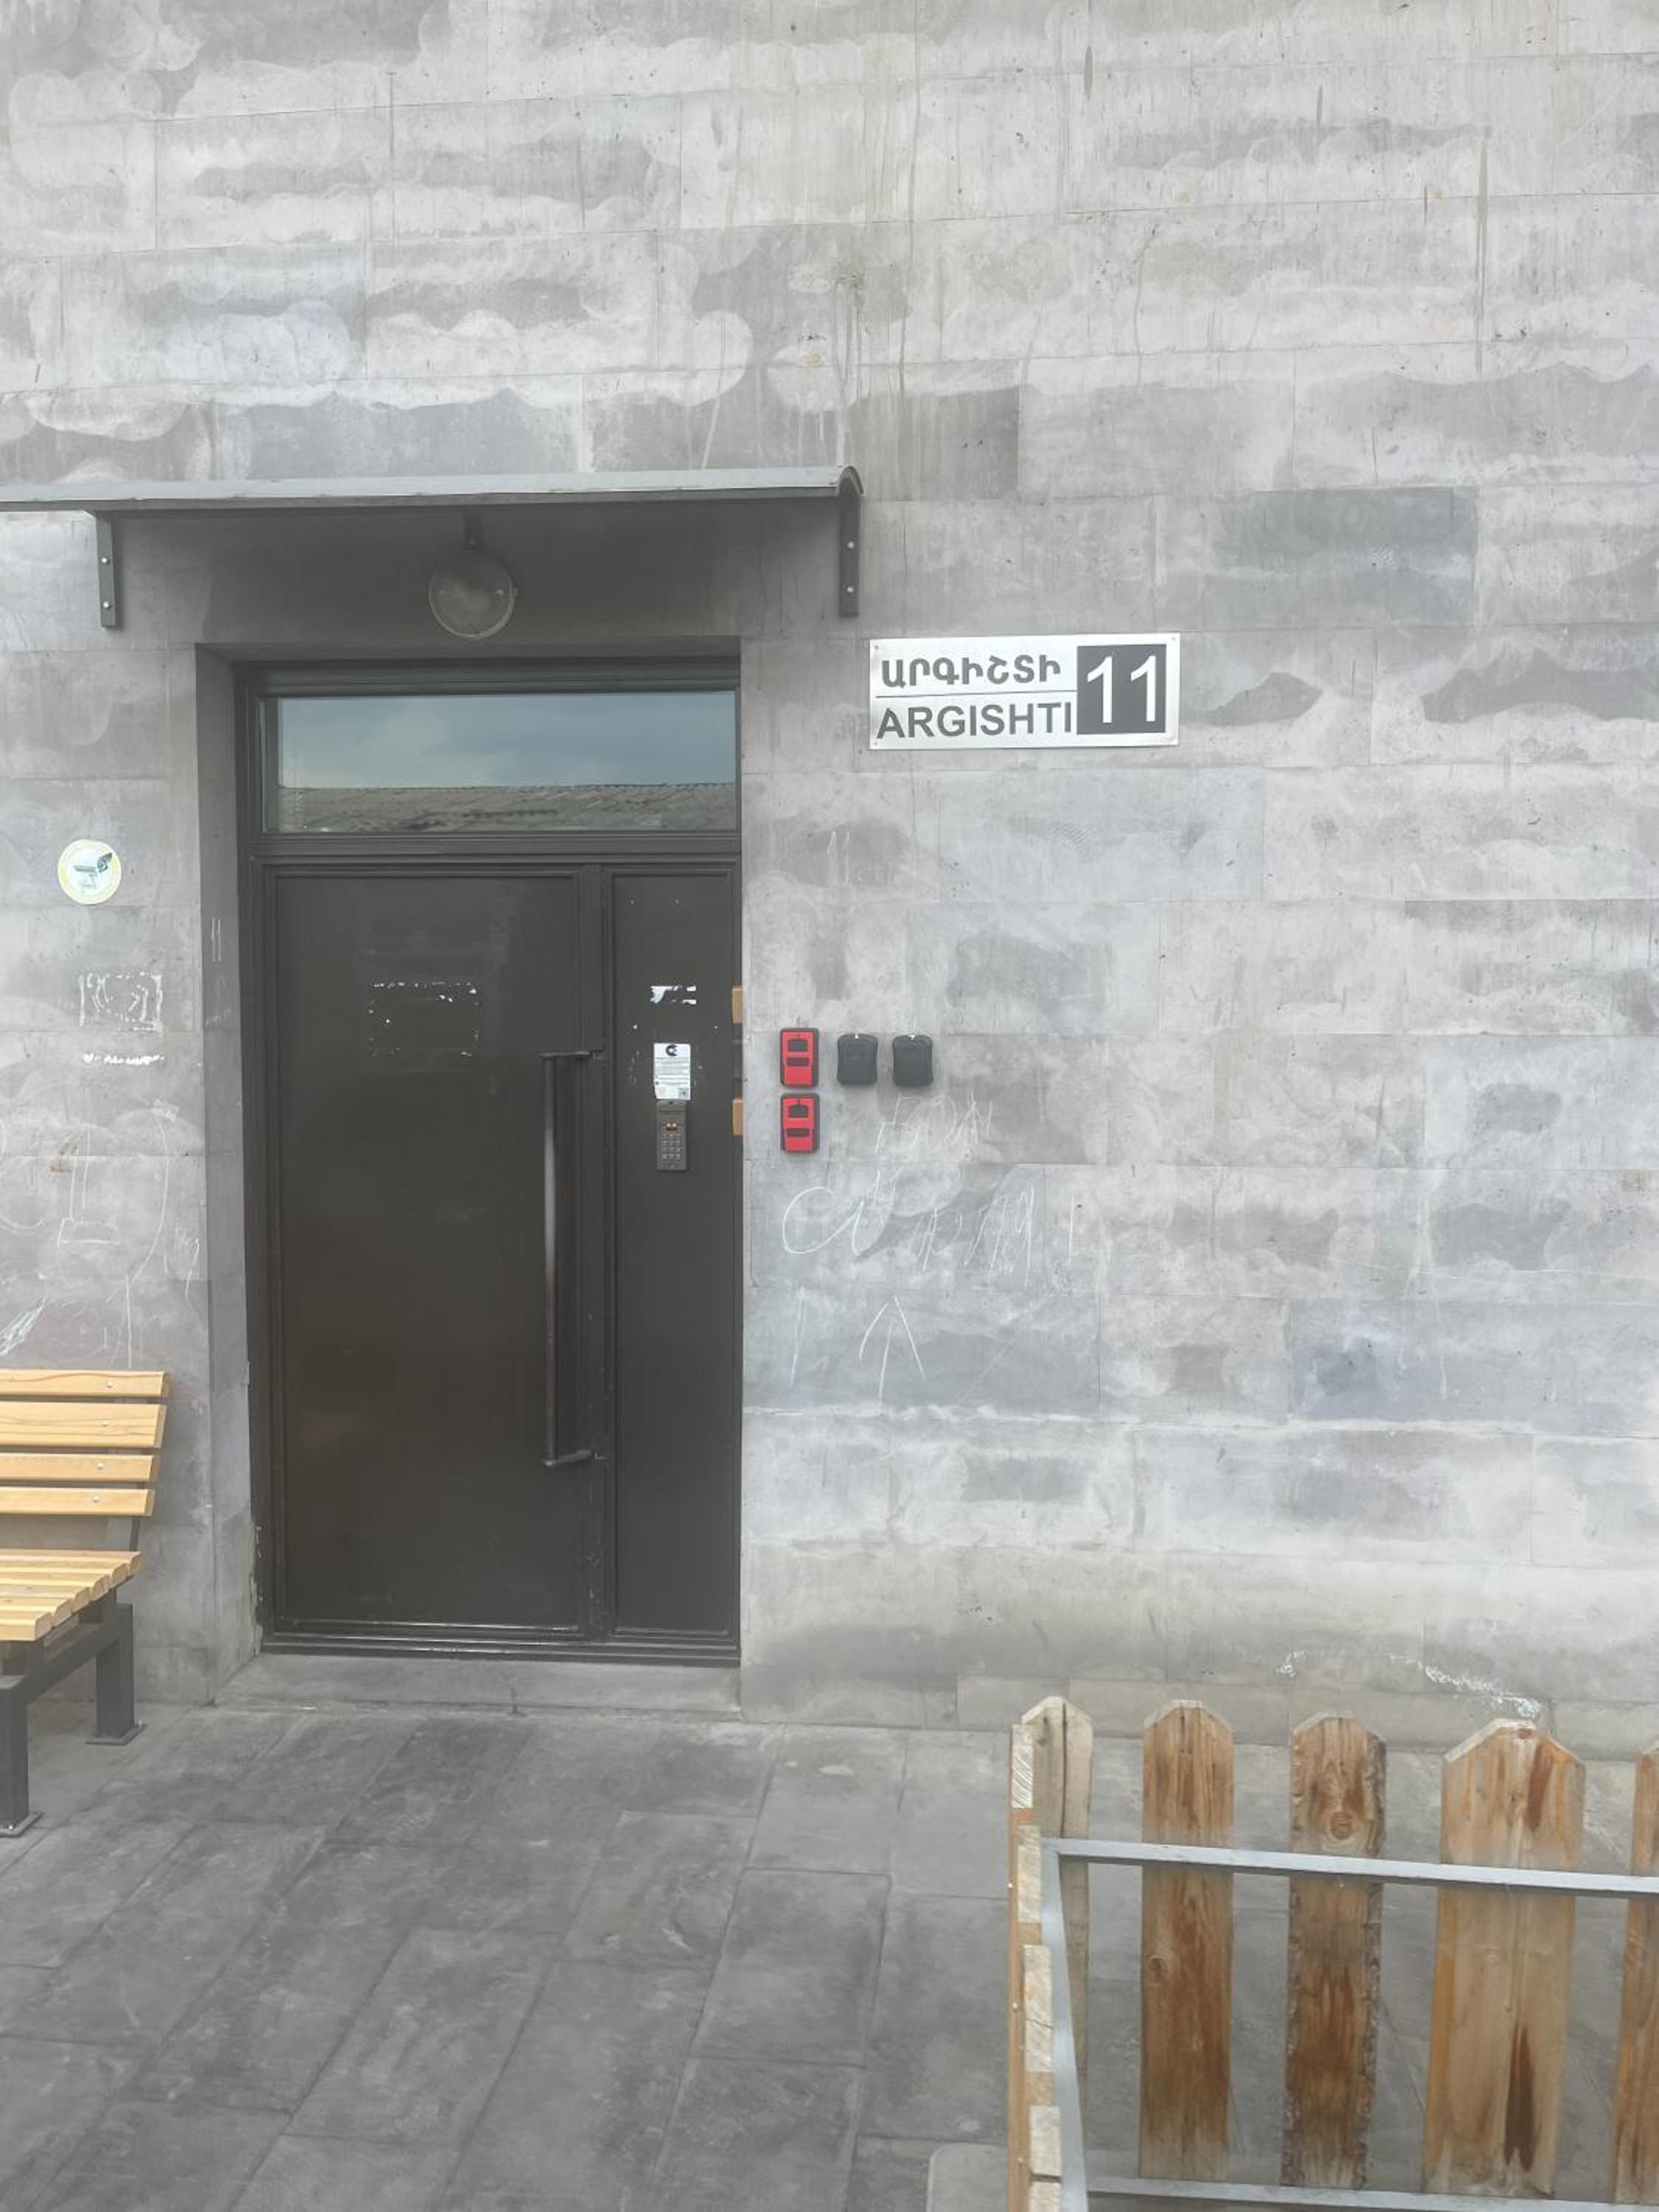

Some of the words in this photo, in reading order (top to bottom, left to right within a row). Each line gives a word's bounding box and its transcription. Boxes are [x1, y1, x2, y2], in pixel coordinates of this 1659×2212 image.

[882, 654, 1061, 689] ԱՐԳԻՇՏԻ
[1087, 655, 1157, 723] 11
[876, 702, 1072, 739] ARGISHTI
